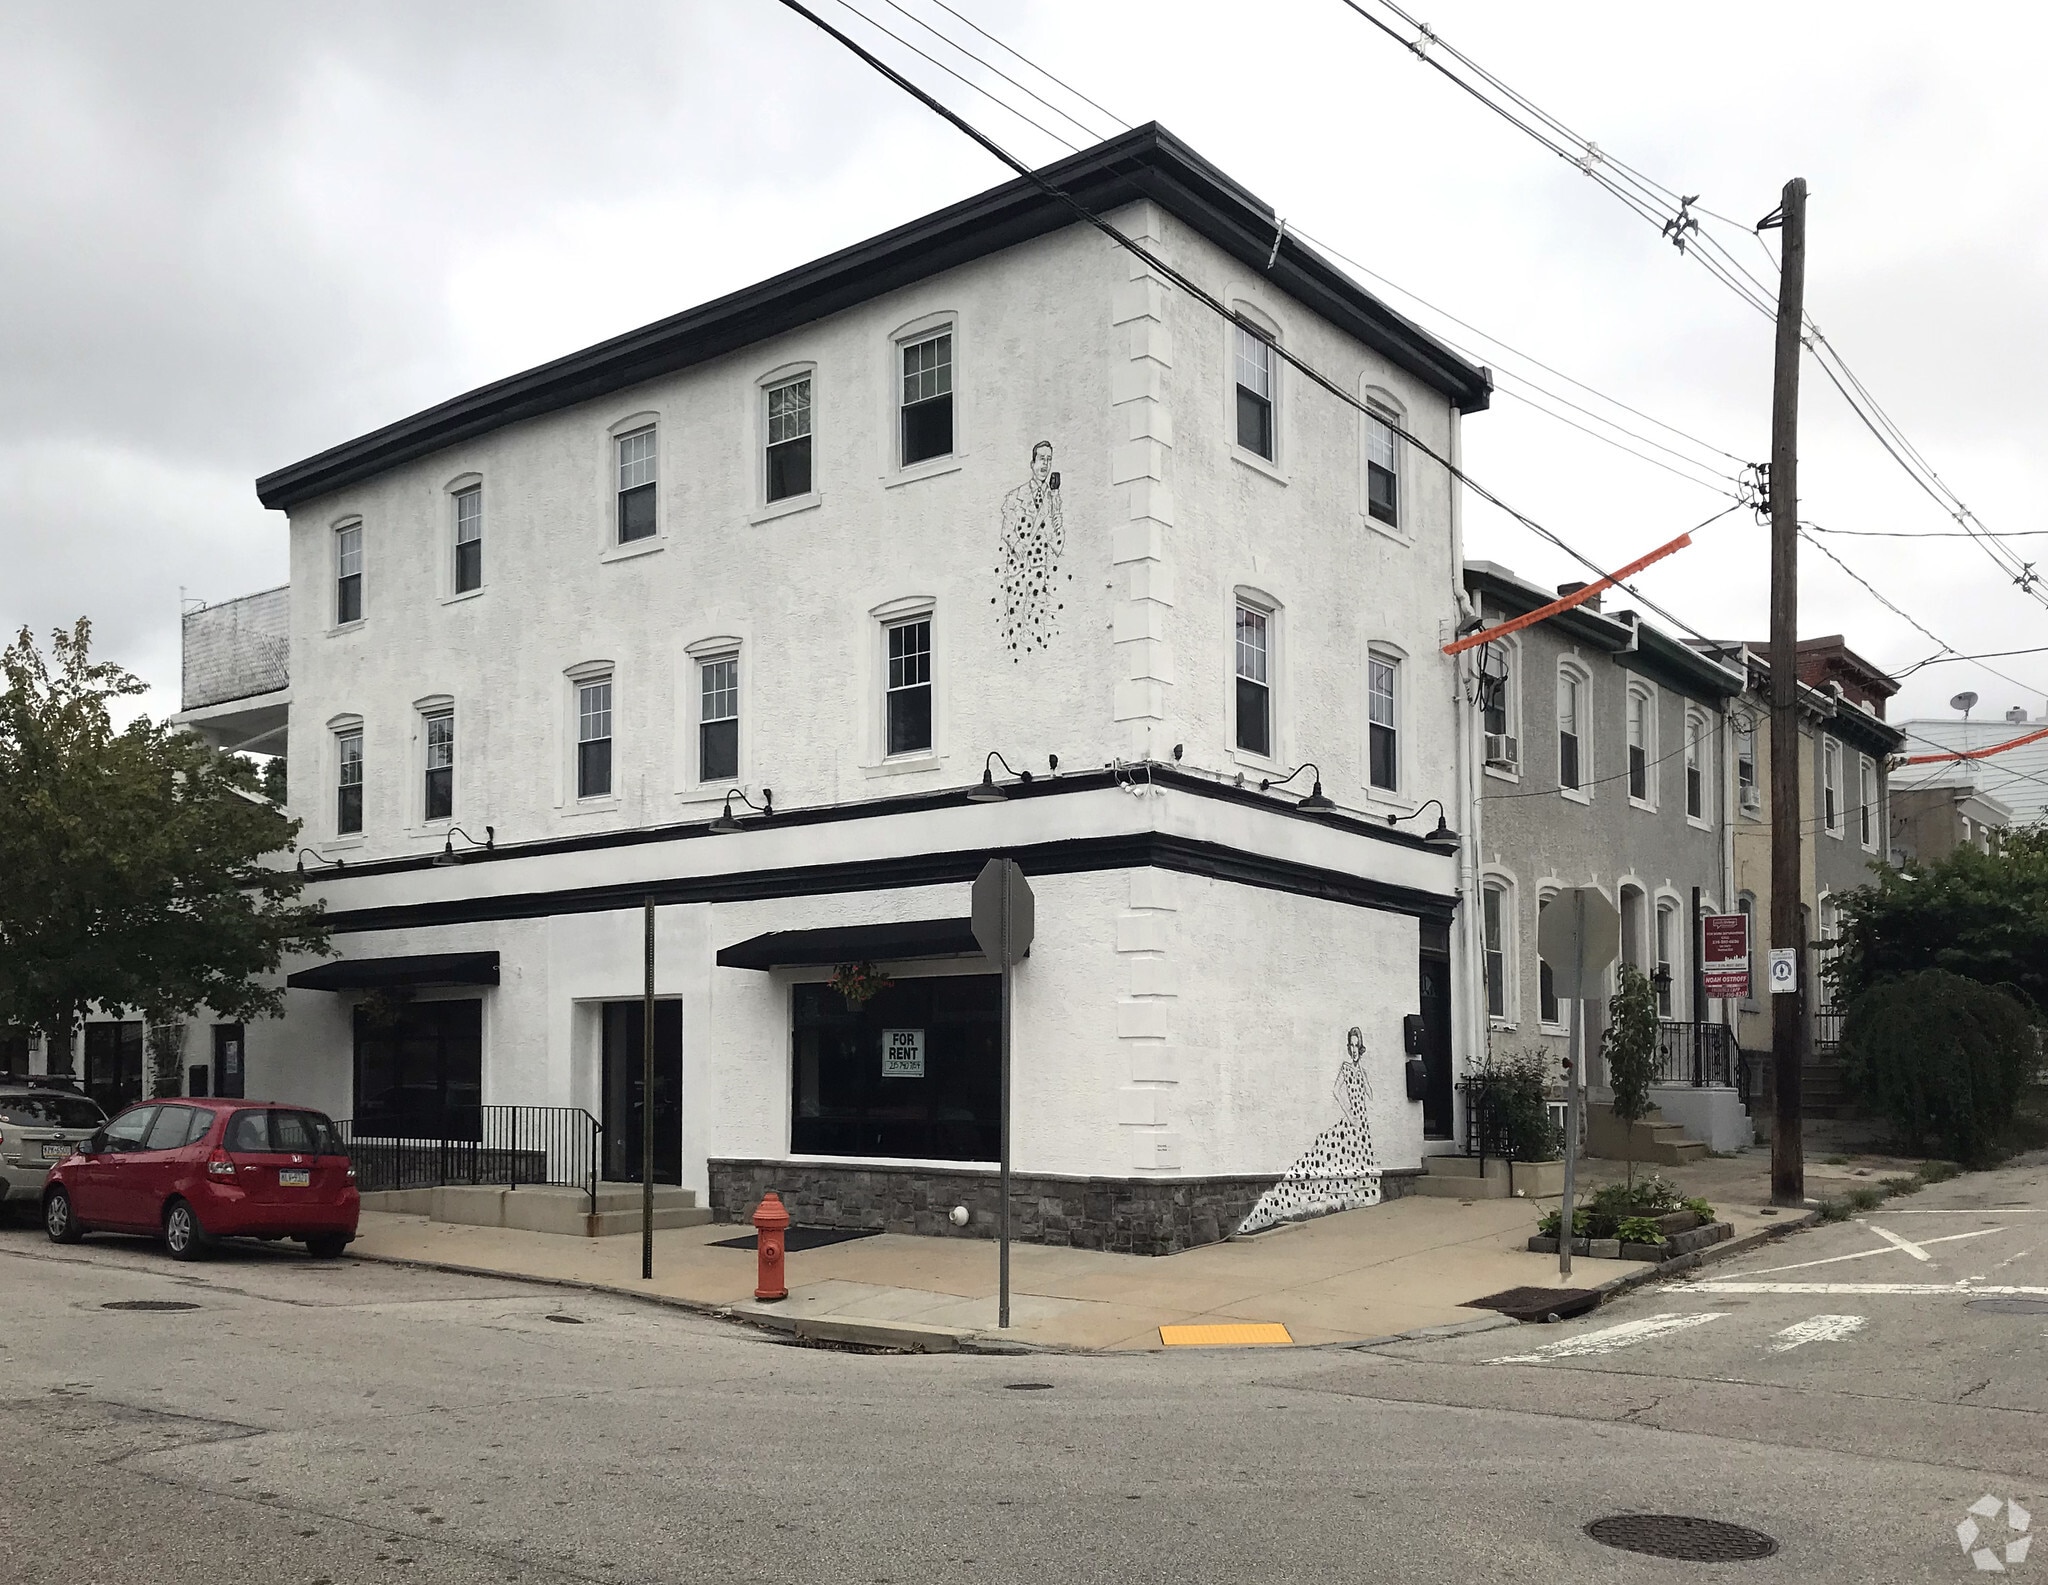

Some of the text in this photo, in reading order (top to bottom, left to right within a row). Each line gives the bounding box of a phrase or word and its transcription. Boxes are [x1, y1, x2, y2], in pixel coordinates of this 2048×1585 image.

[1722, 975, 1747, 983] OSTROFF
[893, 1033, 914, 1046] FOR
[889, 1047, 918, 1060] RENT
